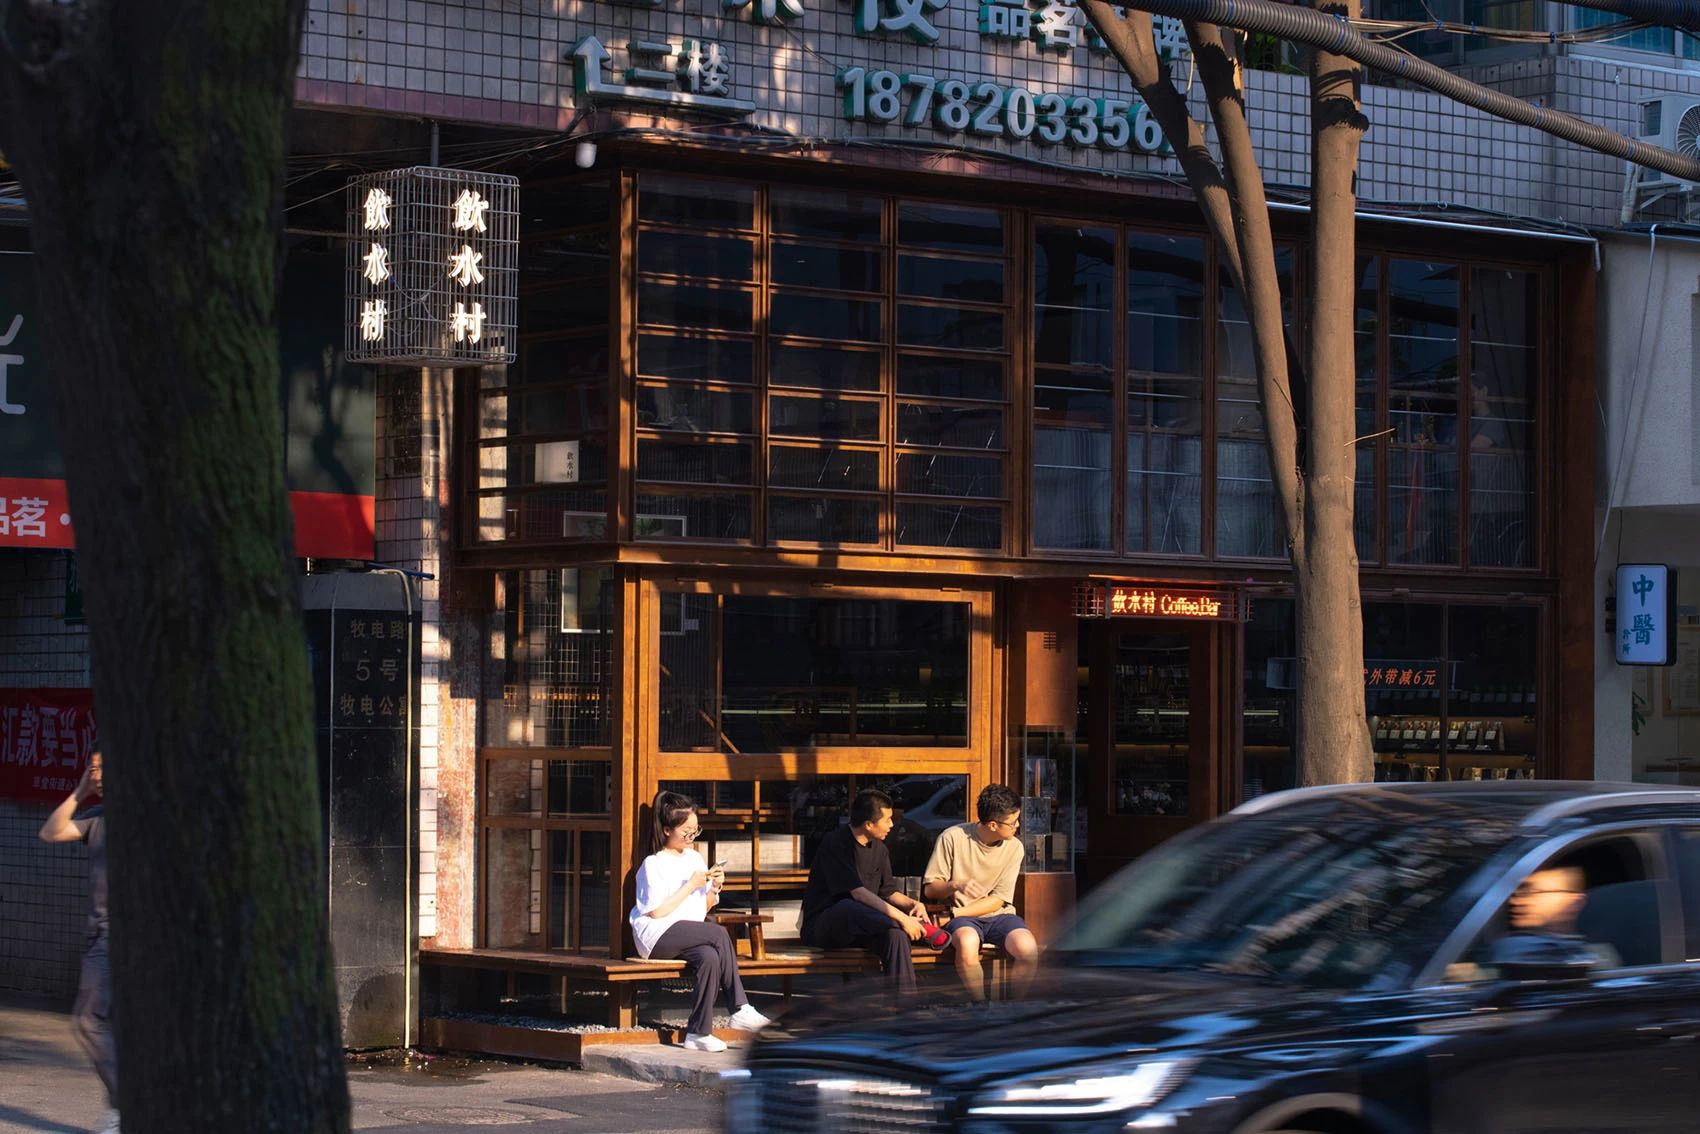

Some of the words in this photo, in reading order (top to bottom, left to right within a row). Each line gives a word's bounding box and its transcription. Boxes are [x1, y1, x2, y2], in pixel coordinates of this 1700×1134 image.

[979, 0, 1190, 57] 品茗牌
[838, 65, 1174, 152] 1878203356
[449, 188, 489, 344] 飲水村
